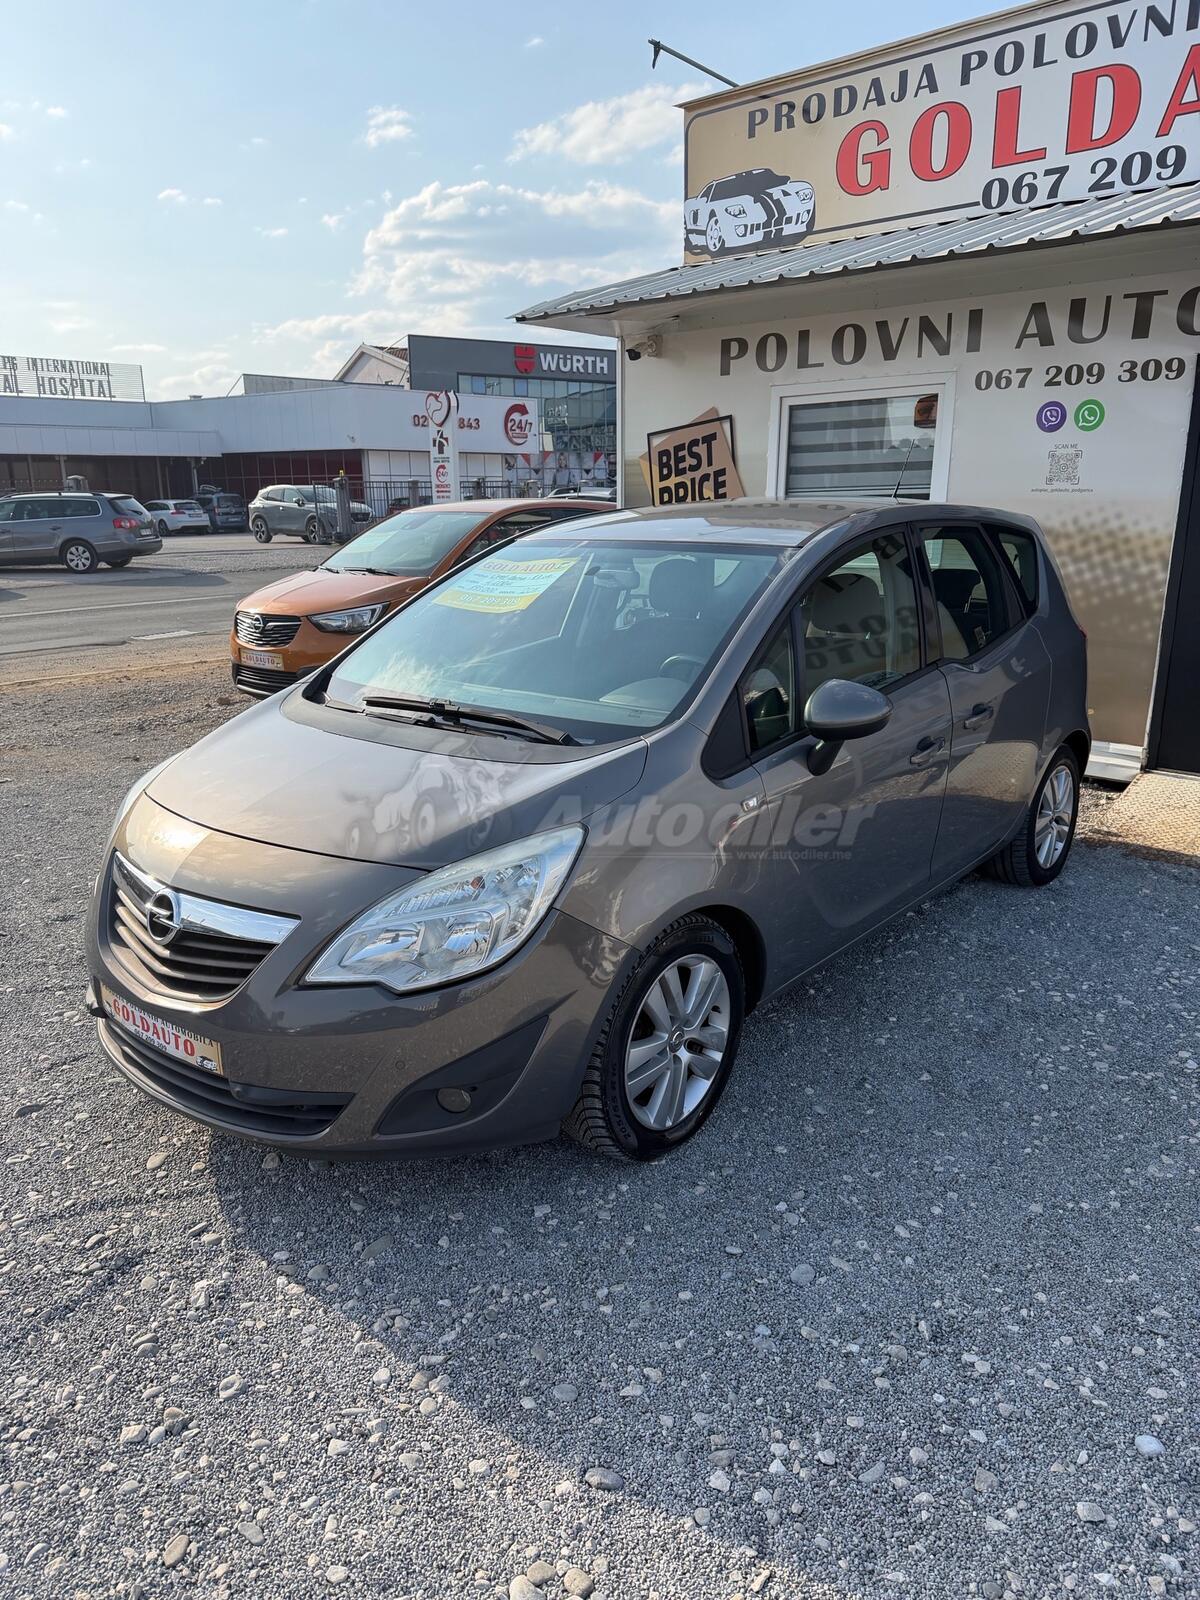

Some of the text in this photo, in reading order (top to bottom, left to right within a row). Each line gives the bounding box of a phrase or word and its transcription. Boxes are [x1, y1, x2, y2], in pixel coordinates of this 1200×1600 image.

[747, 0, 1200, 139] PRODAJA POLOVNI
[835, 43, 1200, 196] GOLDA
[981, 144, 1187, 211] 067 209
[539, 352, 609, 375] WÜRTH
[719, 308, 985, 377] POLOVNI
[26, 356, 113, 377] INTERNATIONAL
[37, 376, 116, 398] HOSPITAL
[974, 357, 1186, 392] 067 209 309
[458, 417, 480, 430] 843
[510, 418, 533, 432] 24/7
[657, 431, 717, 482] BEST
[112, 998, 196, 1057] GOLDAUTO
